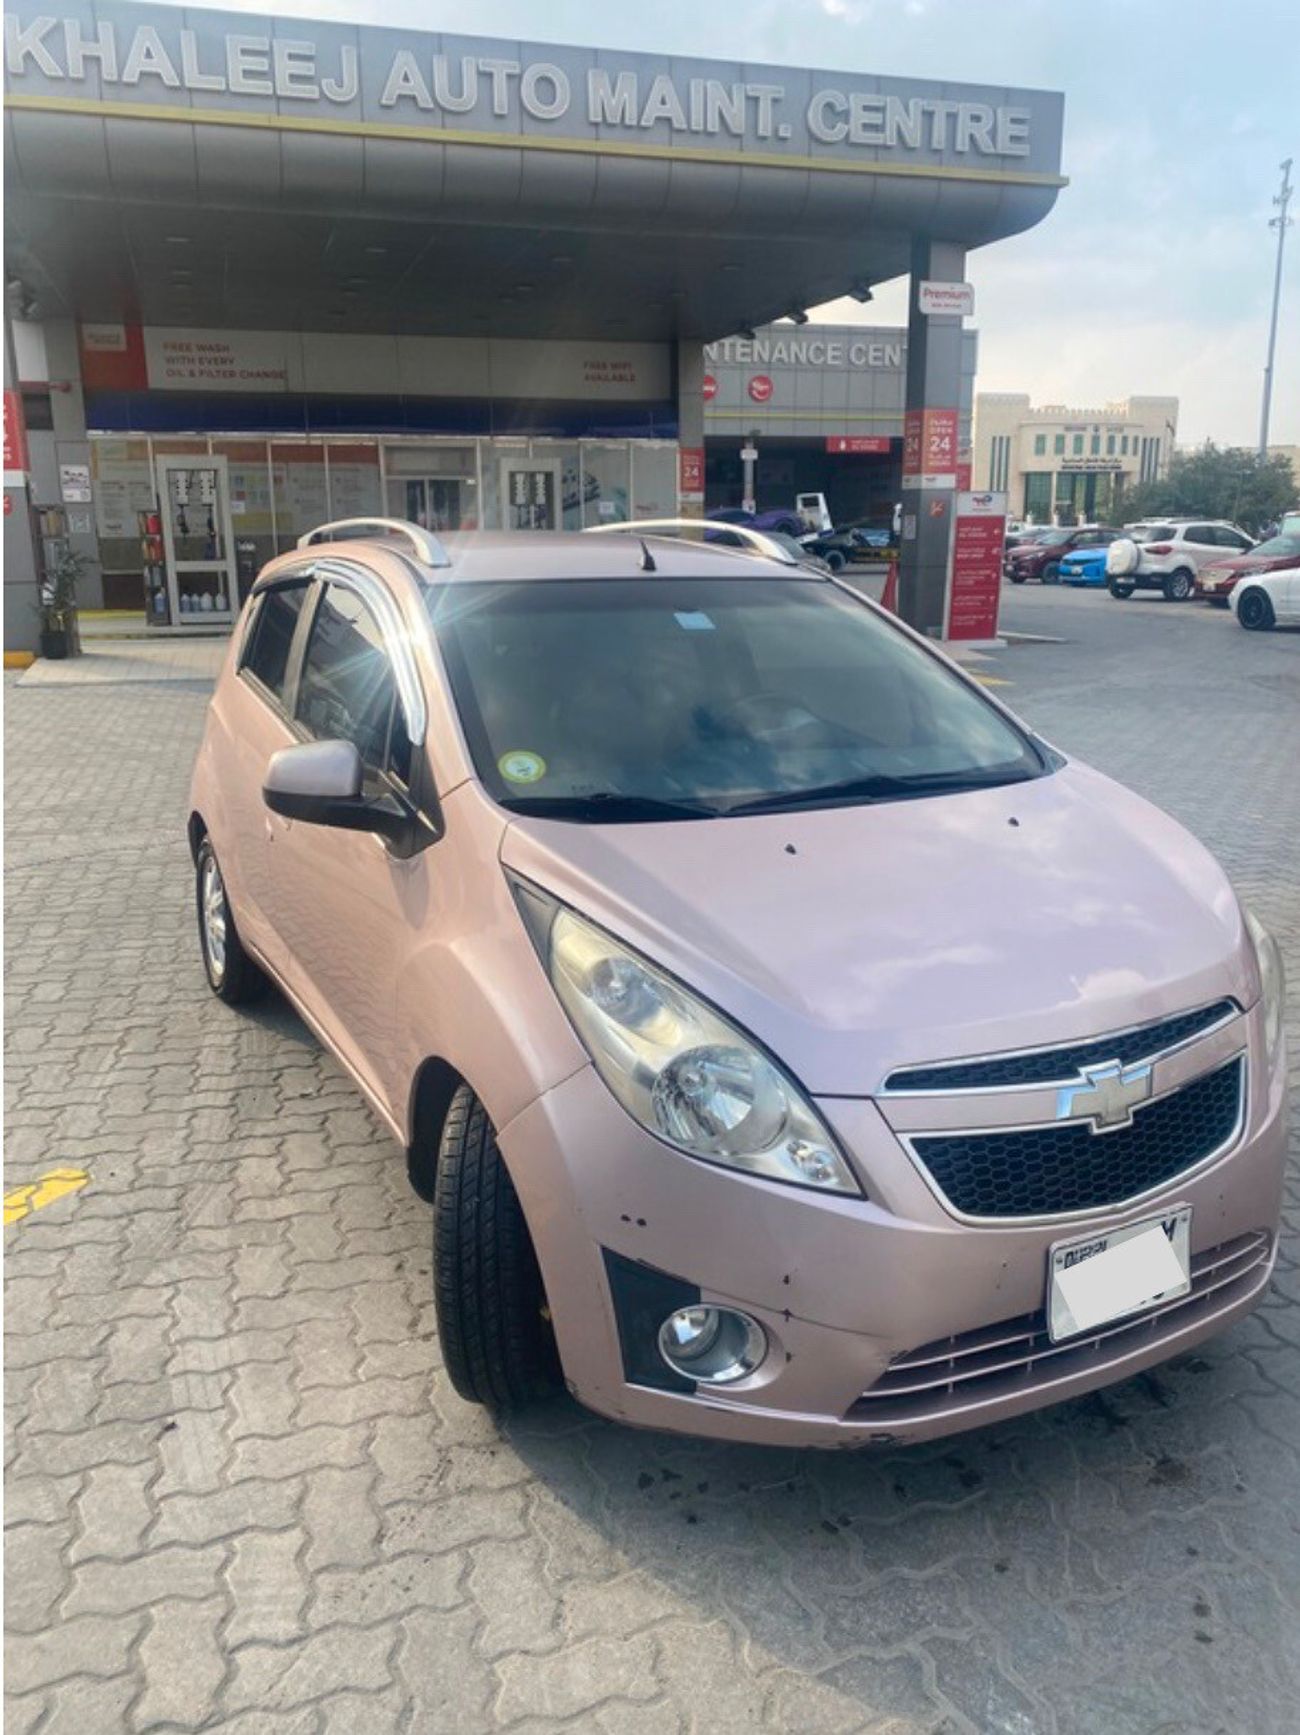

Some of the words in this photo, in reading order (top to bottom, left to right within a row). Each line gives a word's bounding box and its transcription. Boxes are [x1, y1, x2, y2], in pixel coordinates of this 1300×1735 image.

[4, 14, 359, 102] KHALEEJ
[380, 50, 571, 120] AUTO
[587, 68, 792, 140] MAINT.
[806, 89, 1031, 157] CENTRE
[850, 342, 909, 367] CEN
[929, 435, 951, 452] 24
